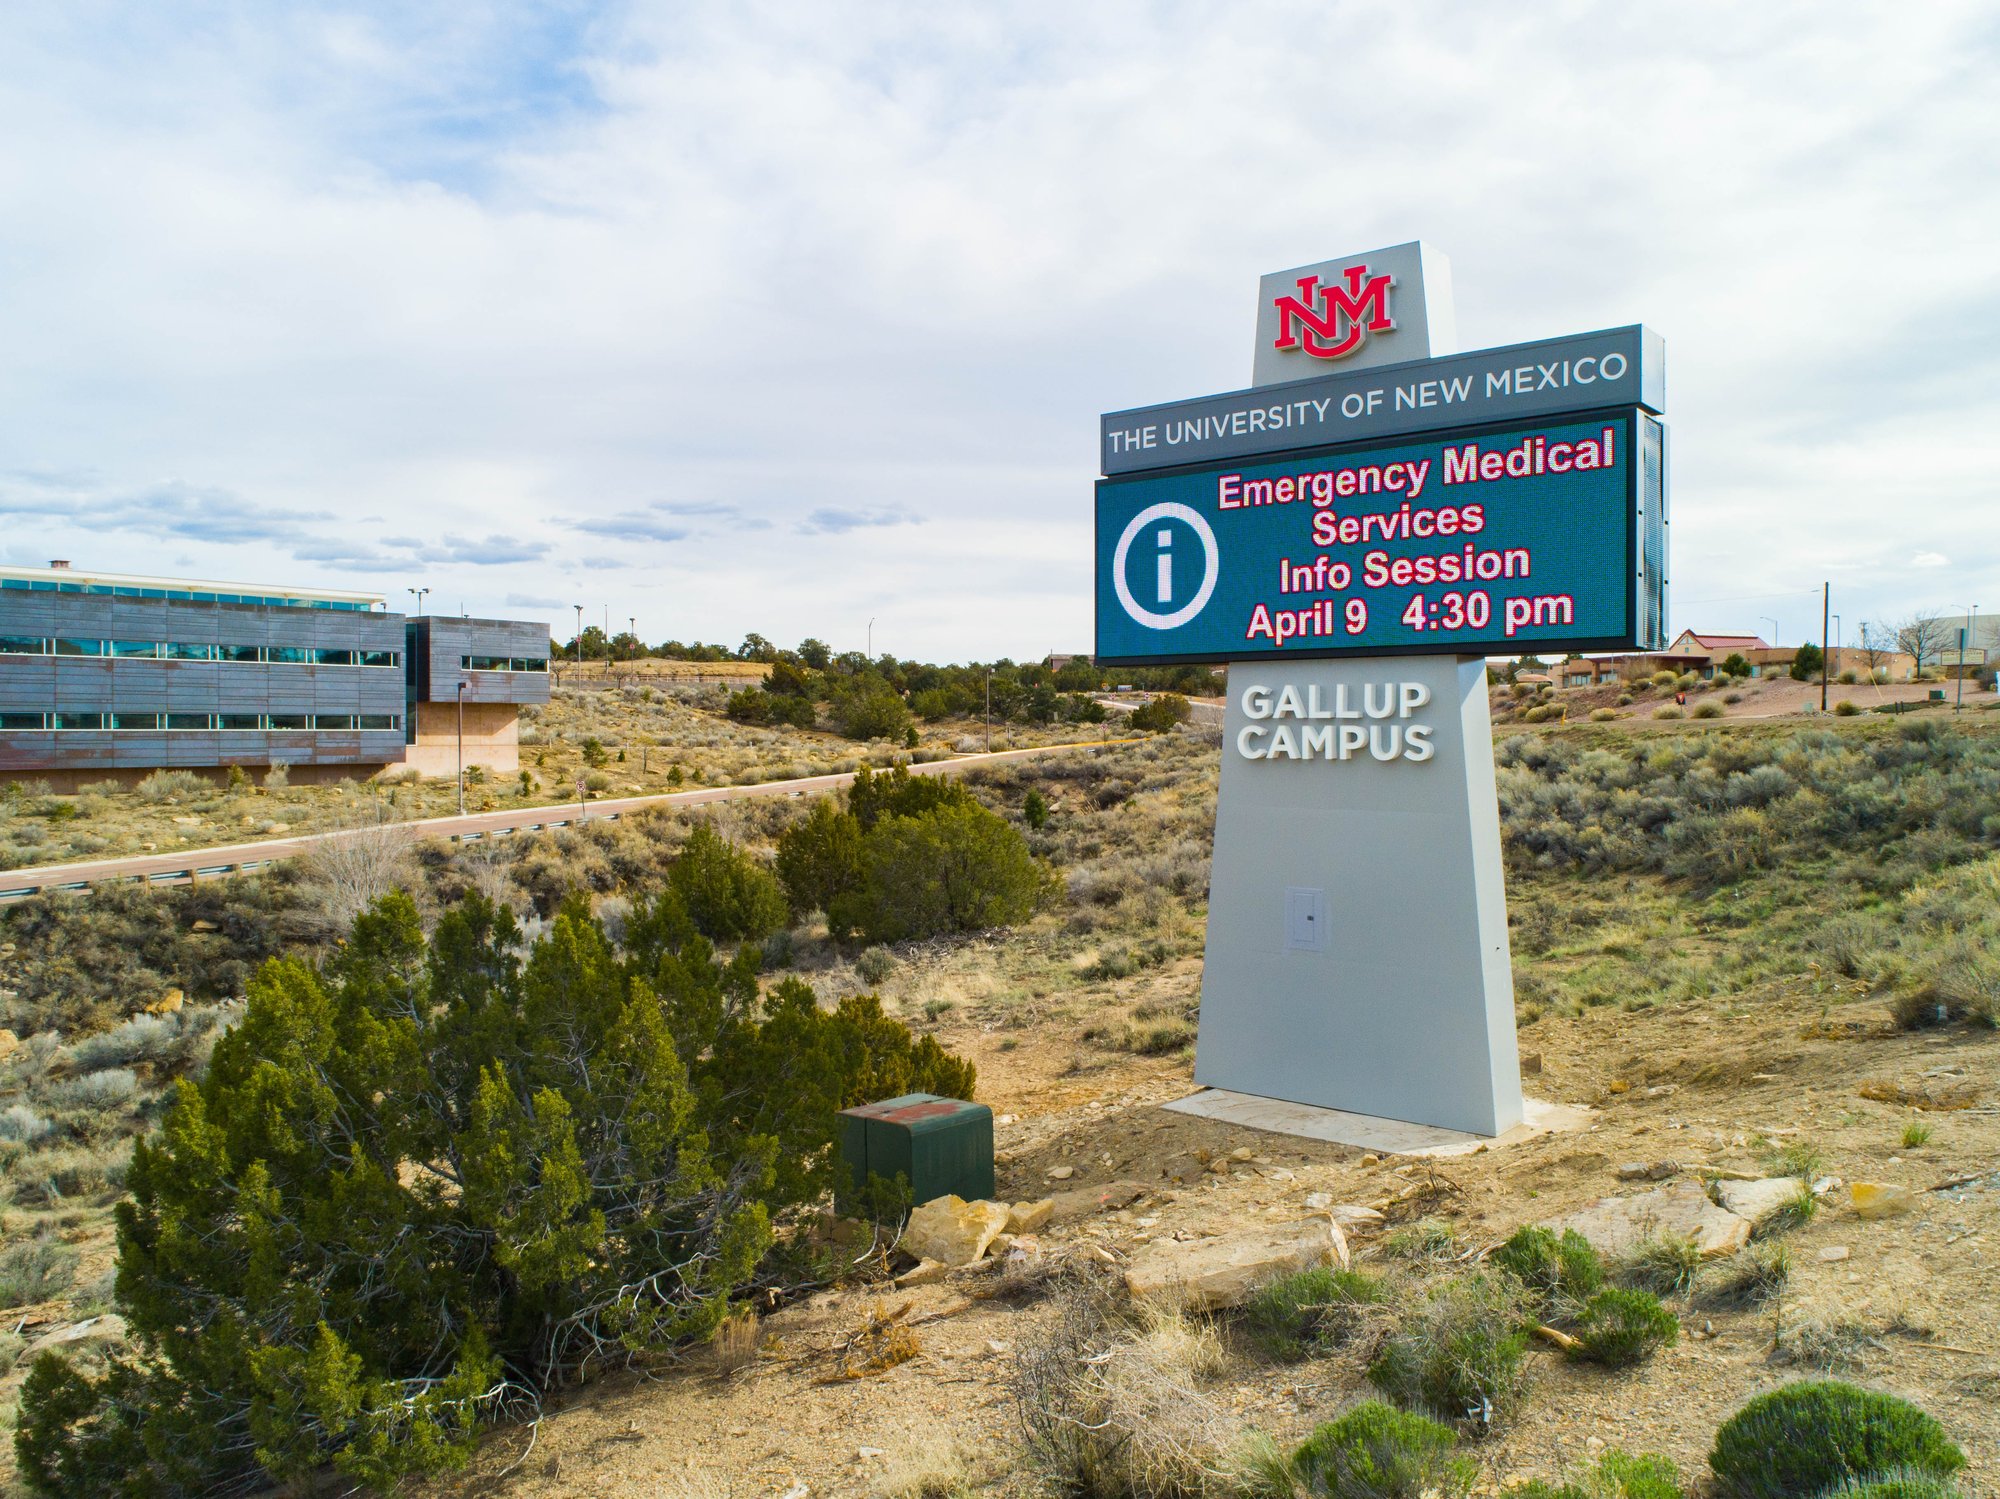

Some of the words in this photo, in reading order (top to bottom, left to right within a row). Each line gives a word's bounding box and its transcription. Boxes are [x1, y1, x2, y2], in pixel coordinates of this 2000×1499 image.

[1109, 425, 1157, 453] THE
[1166, 397, 1332, 445] UNIVERSITY
[1341, 388, 1384, 419] OF
[1395, 375, 1473, 411] NEW
[1485, 352, 1628, 397] MEXICO
[1218, 459, 1430, 511] Emergency
[1443, 428, 1615, 486] Medical
[1312, 503, 1485, 548] Services
[1280, 556, 1352, 594] Info
[1363, 544, 1531, 587] Session
[1246, 601, 1333, 646] April
[1344, 598, 1368, 635] 9
[1402, 591, 1489, 633] 4:30
[1505, 593, 1574, 636] pm
[1241, 682, 1431, 720] GALLUP
[1237, 724, 1435, 762] CAMPUS
